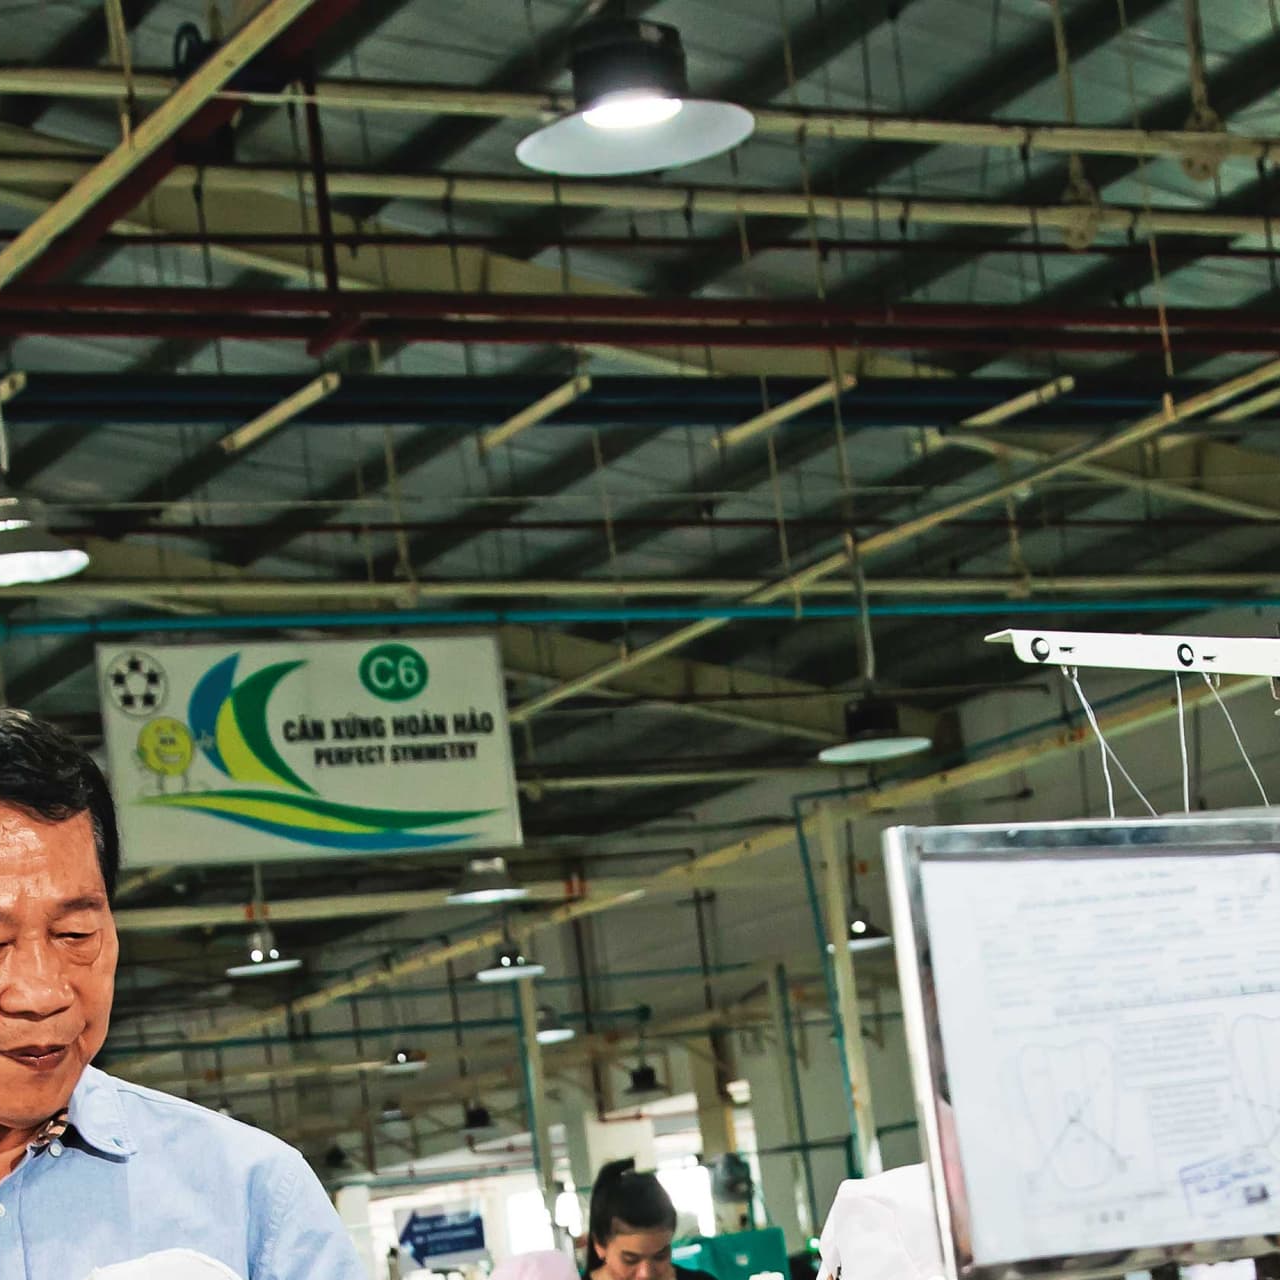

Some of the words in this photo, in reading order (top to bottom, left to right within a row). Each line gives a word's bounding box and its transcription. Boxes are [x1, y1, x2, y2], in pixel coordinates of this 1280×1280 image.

[368, 655, 420, 690] C6
[391, 709, 448, 736] HOÀN
[314, 744, 385, 767] PERFECT
[390, 740, 478, 763] SYMMETRY
